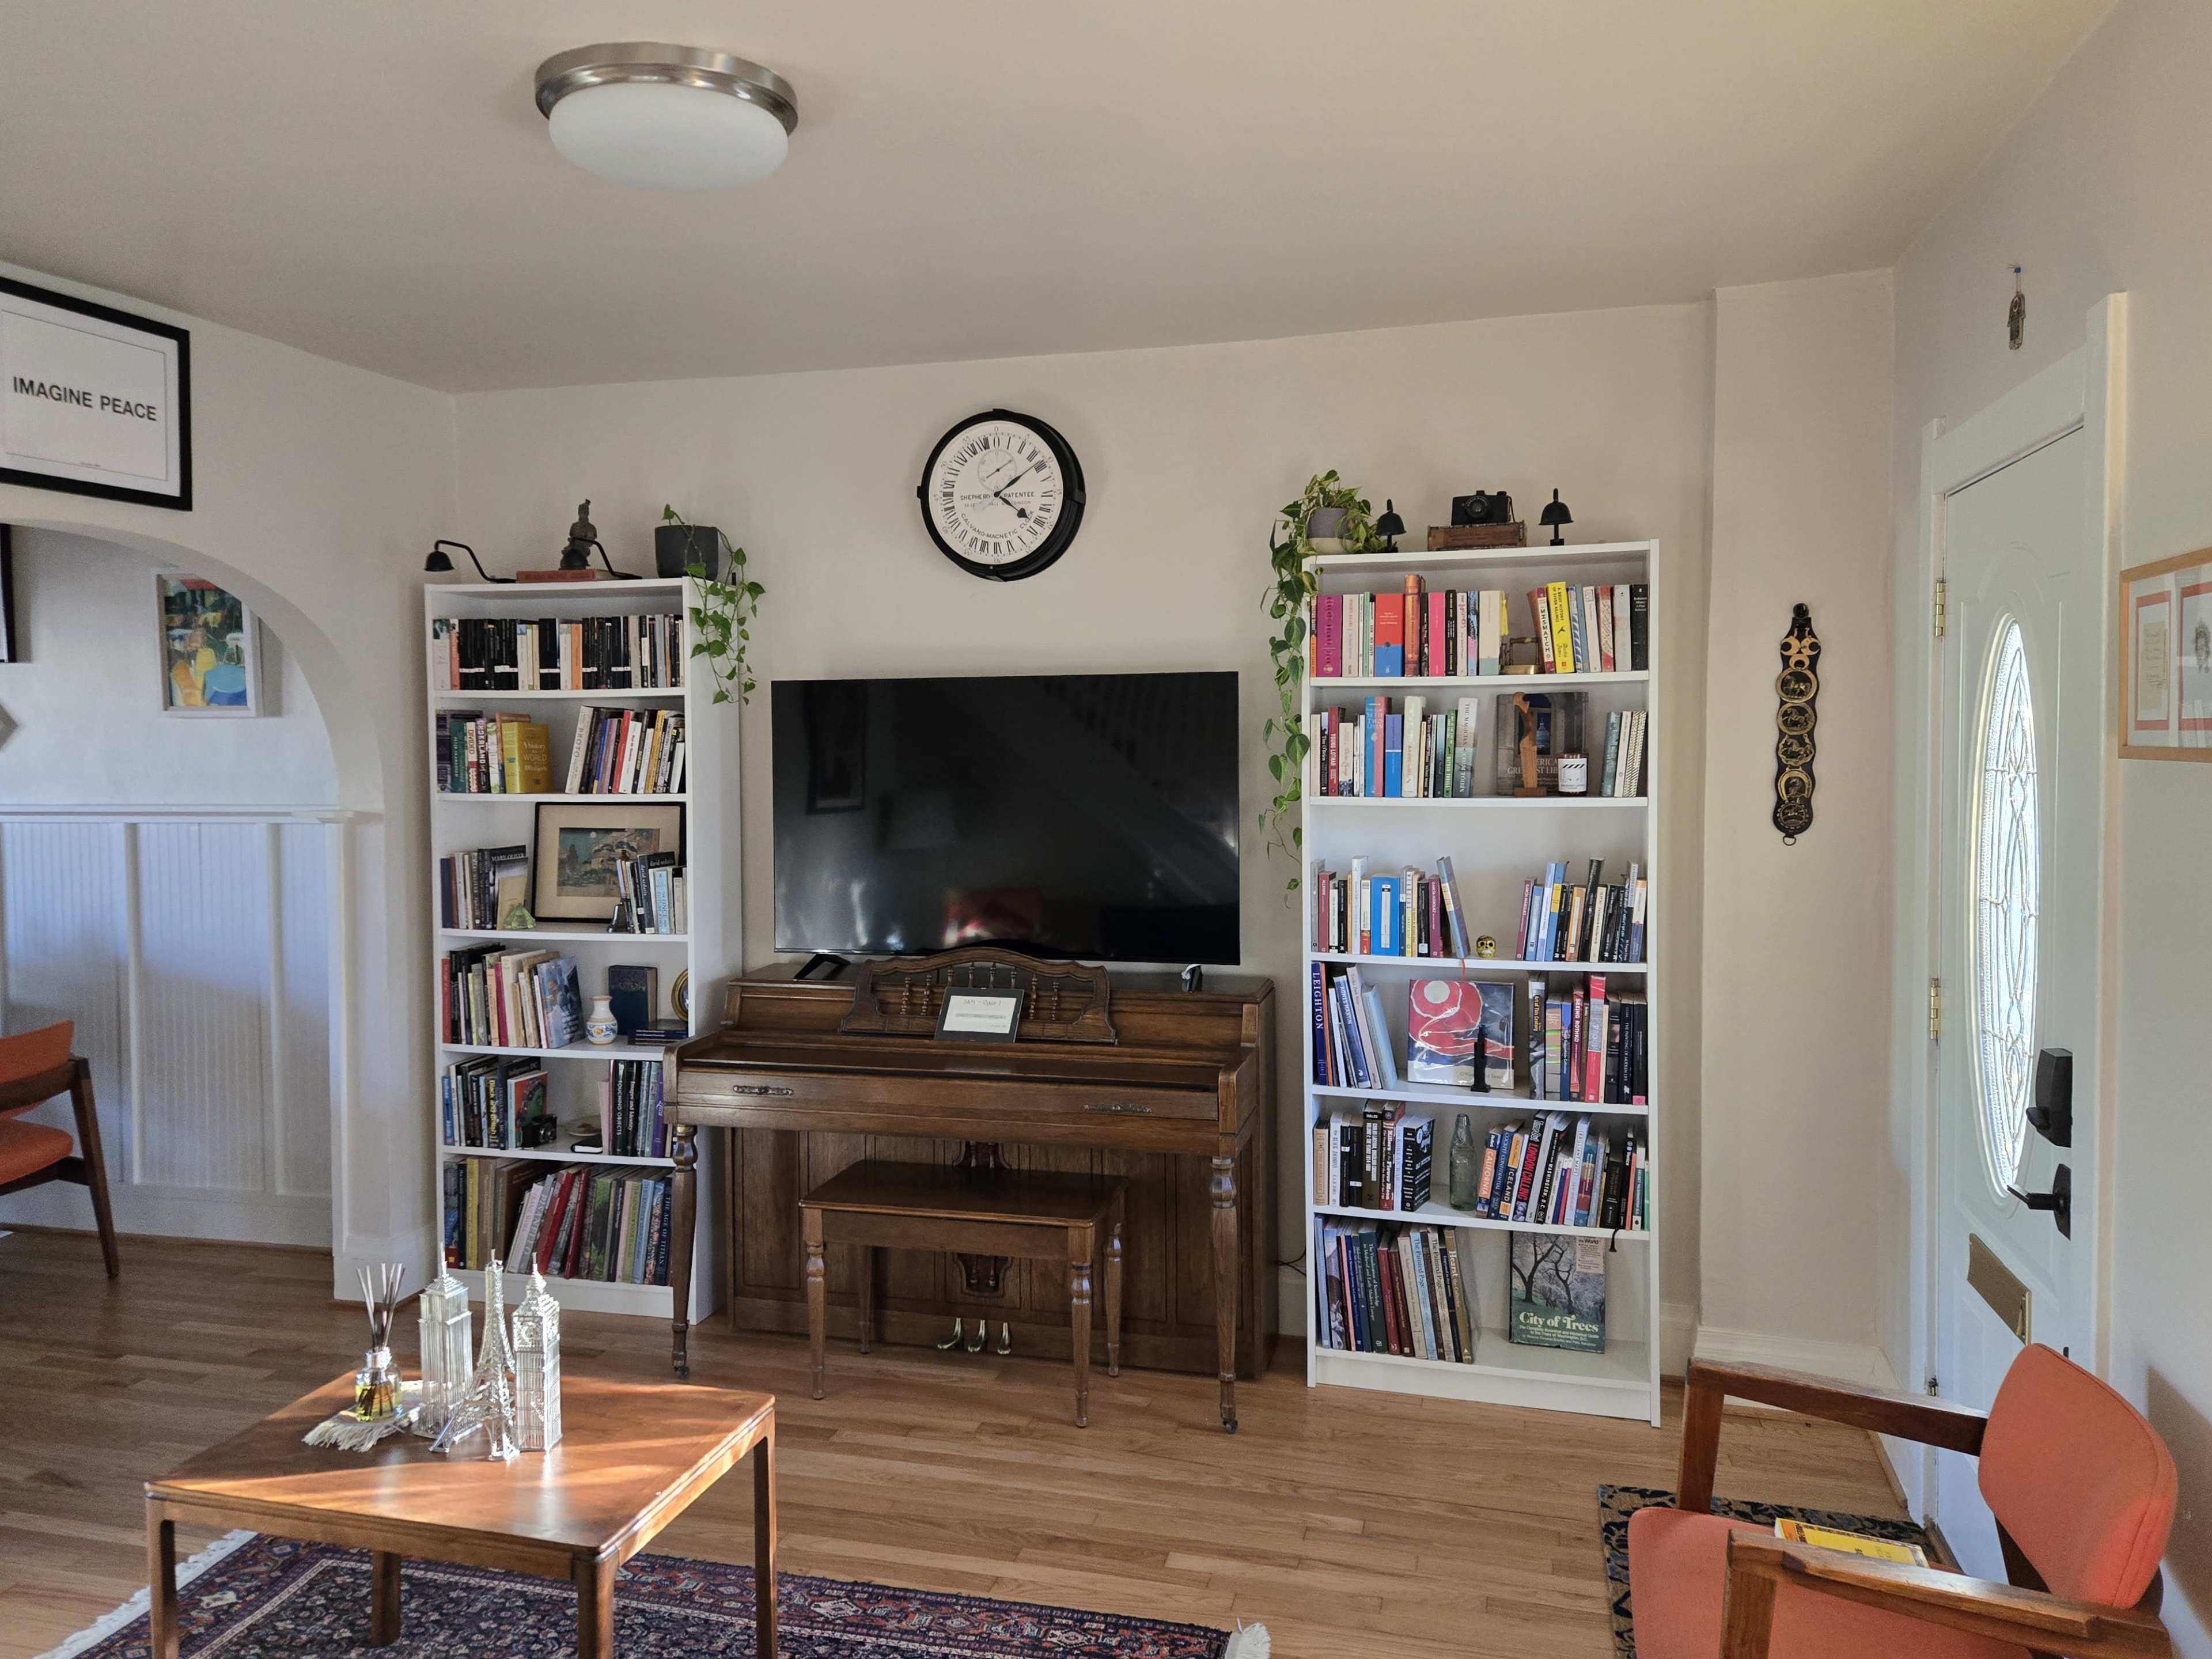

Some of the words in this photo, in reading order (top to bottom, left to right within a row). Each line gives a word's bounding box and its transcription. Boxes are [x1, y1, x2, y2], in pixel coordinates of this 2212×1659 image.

[13, 376, 93, 408] IMAGINE
[101, 396, 157, 422] PEACE
[1540, 609, 1551, 652] MISMATCH
[476, 721, 486, 764] UNDERLAND
[573, 728, 584, 758] PROTO
[1313, 972, 1323, 1029] LEIGHTON
[1342, 1005, 1352, 1025] MARTIN
[1524, 1143, 1539, 1171] LONDON
[1482, 1152, 1494, 1195] CALIFORNIA
[1495, 1155, 1505, 1190] CONFIDENTIAL
[1504, 1169, 1514, 1202] ICELAND
[1517, 1172, 1531, 1200] CALLING
[1542, 1164, 1553, 1198] WASHINGTON,
[662, 1229, 667, 1237] OF
[1416, 1251, 1424, 1273] Painted
[1433, 1252, 1442, 1274] Painted
[1449, 1251, 1459, 1277] Hearst
[1435, 1275, 1444, 1290] Page
[1520, 1312, 1545, 1328] City
[1547, 1316, 1560, 1328] of
[1562, 1315, 1599, 1332] Trees
